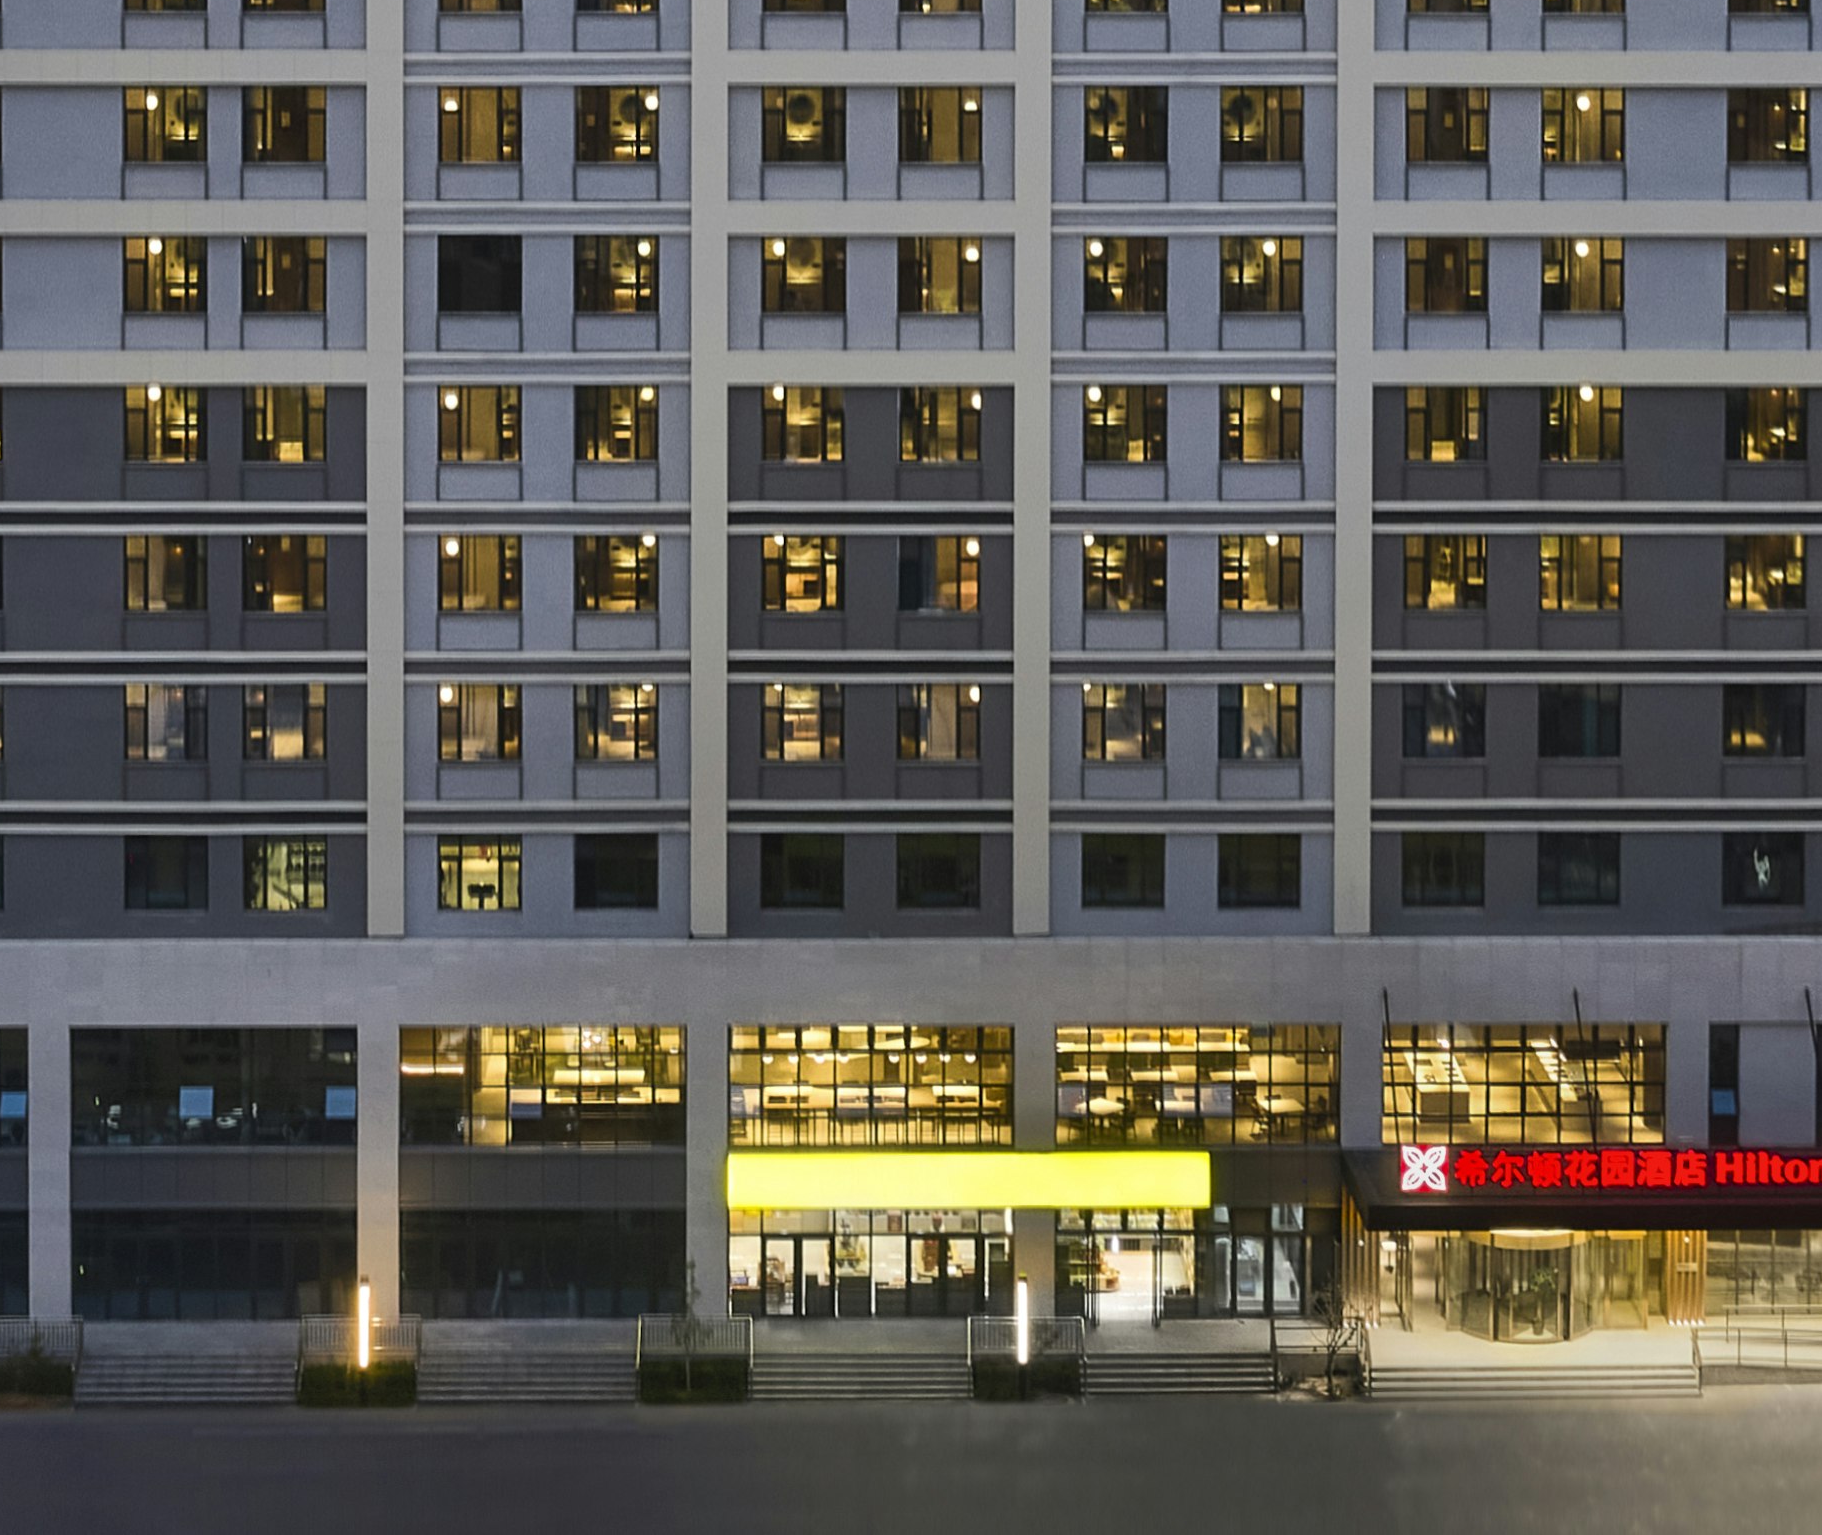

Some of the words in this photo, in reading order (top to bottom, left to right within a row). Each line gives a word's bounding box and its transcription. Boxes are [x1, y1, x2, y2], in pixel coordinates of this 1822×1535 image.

[1454, 1148, 1707, 1188] 希尔顿花园酒店
